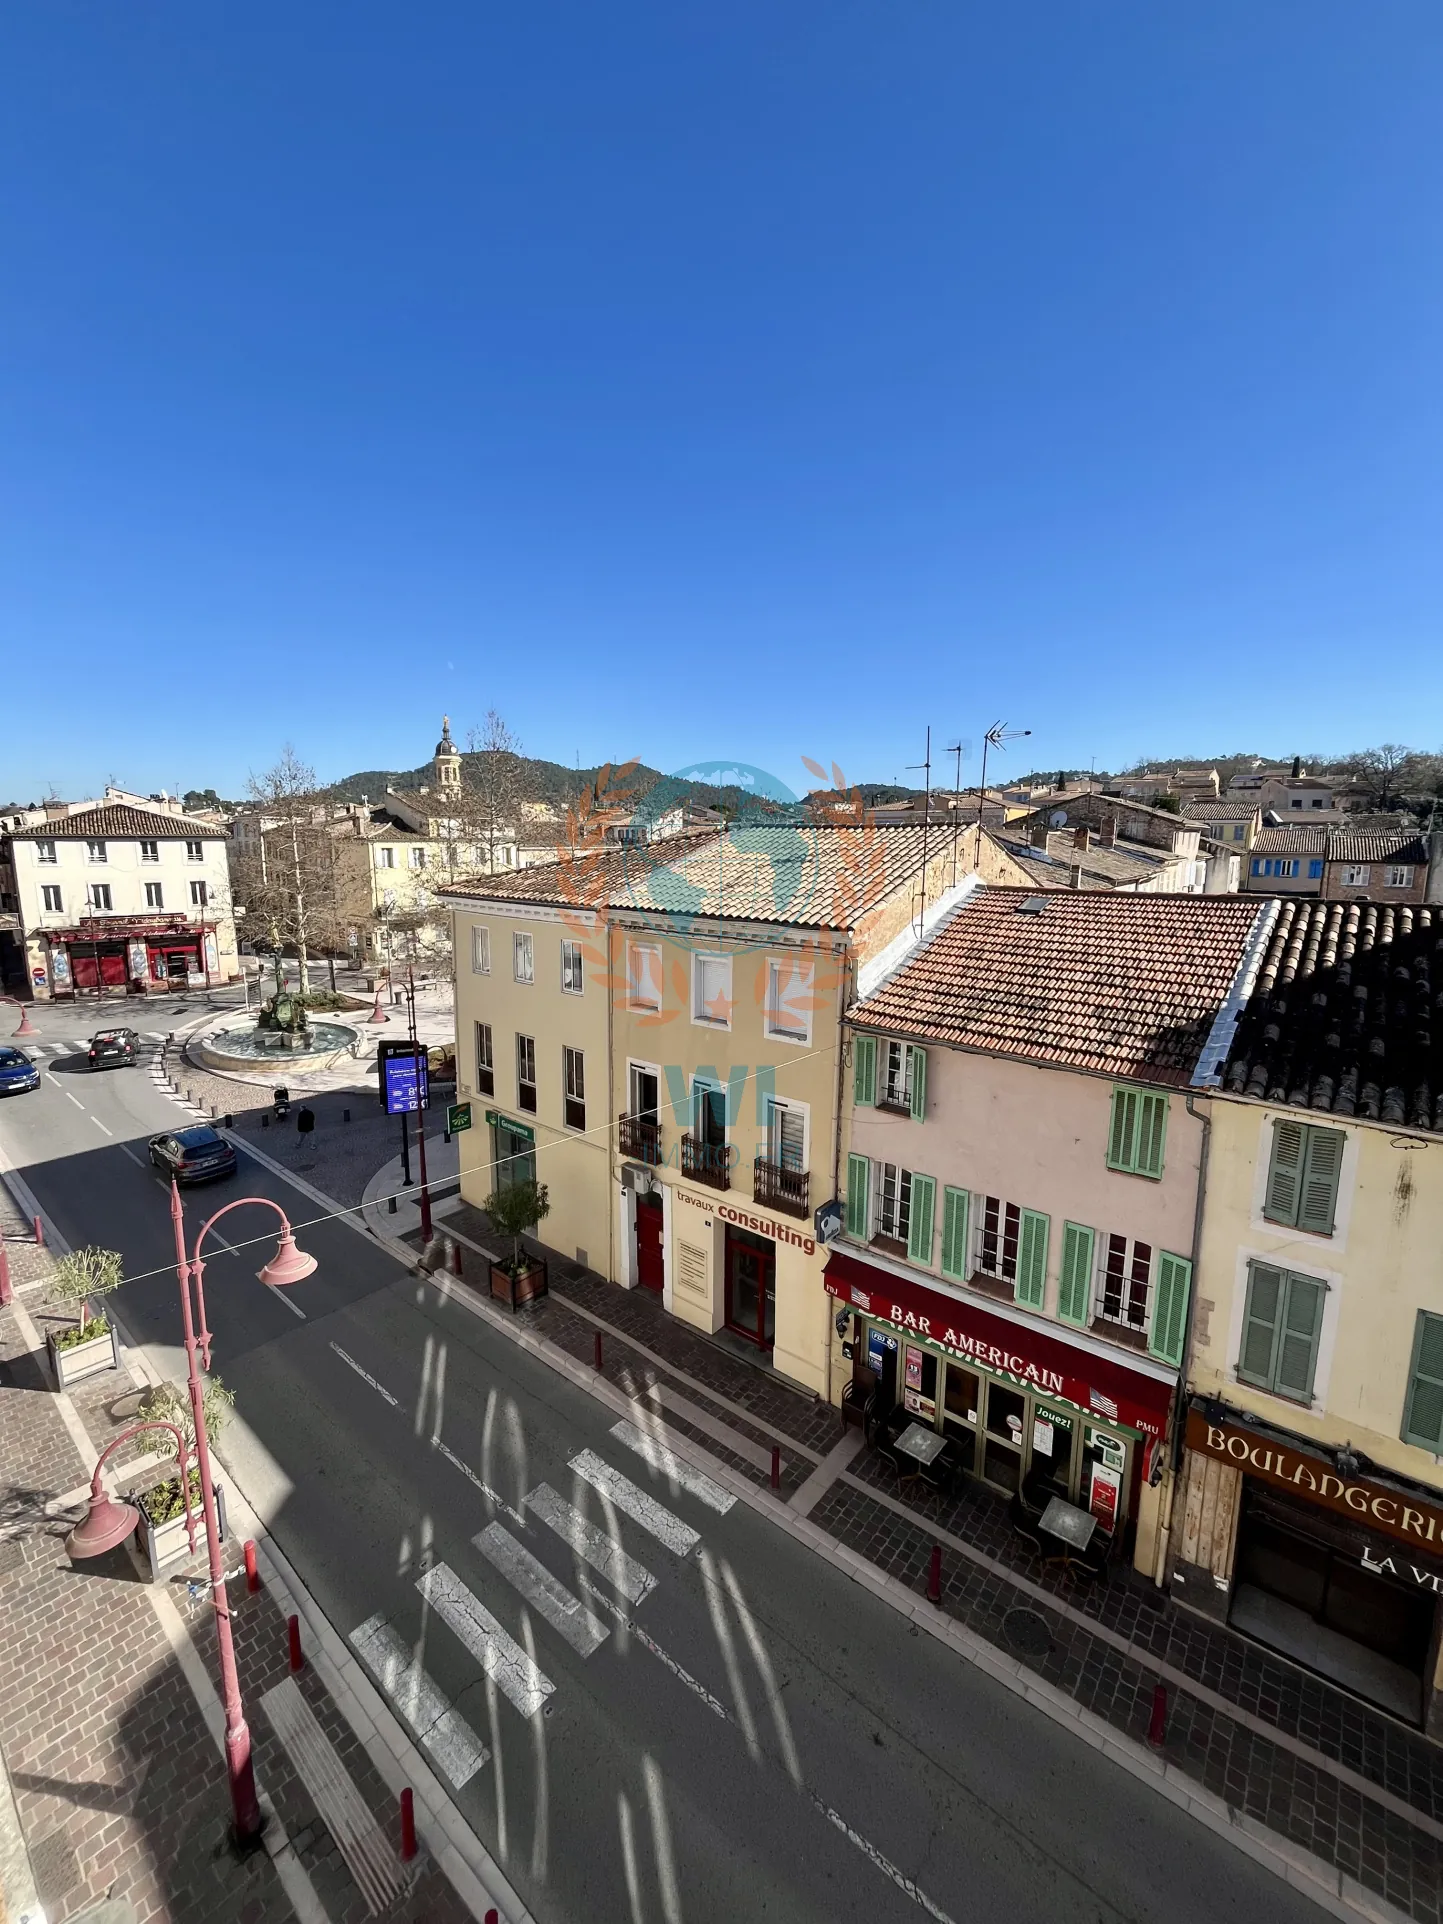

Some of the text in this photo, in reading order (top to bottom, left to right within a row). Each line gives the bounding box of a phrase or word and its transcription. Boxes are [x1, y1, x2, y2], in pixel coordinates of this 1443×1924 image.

[501, 1119, 528, 1136] Groupama
[677, 1190, 815, 1255] travaux consulting
[826, 1284, 838, 1295] FDJ
[874, 1333, 886, 1342] FDJ
[891, 1305, 931, 1335] BAR
[942, 1328, 1064, 1393] AMERICAIN
[1037, 1407, 1071, 1428] Jouez!
[1136, 1419, 1159, 1435] PMU
[1206, 1426, 1443, 1542] BOULANGERI
[1362, 1546, 1398, 1574] LA
